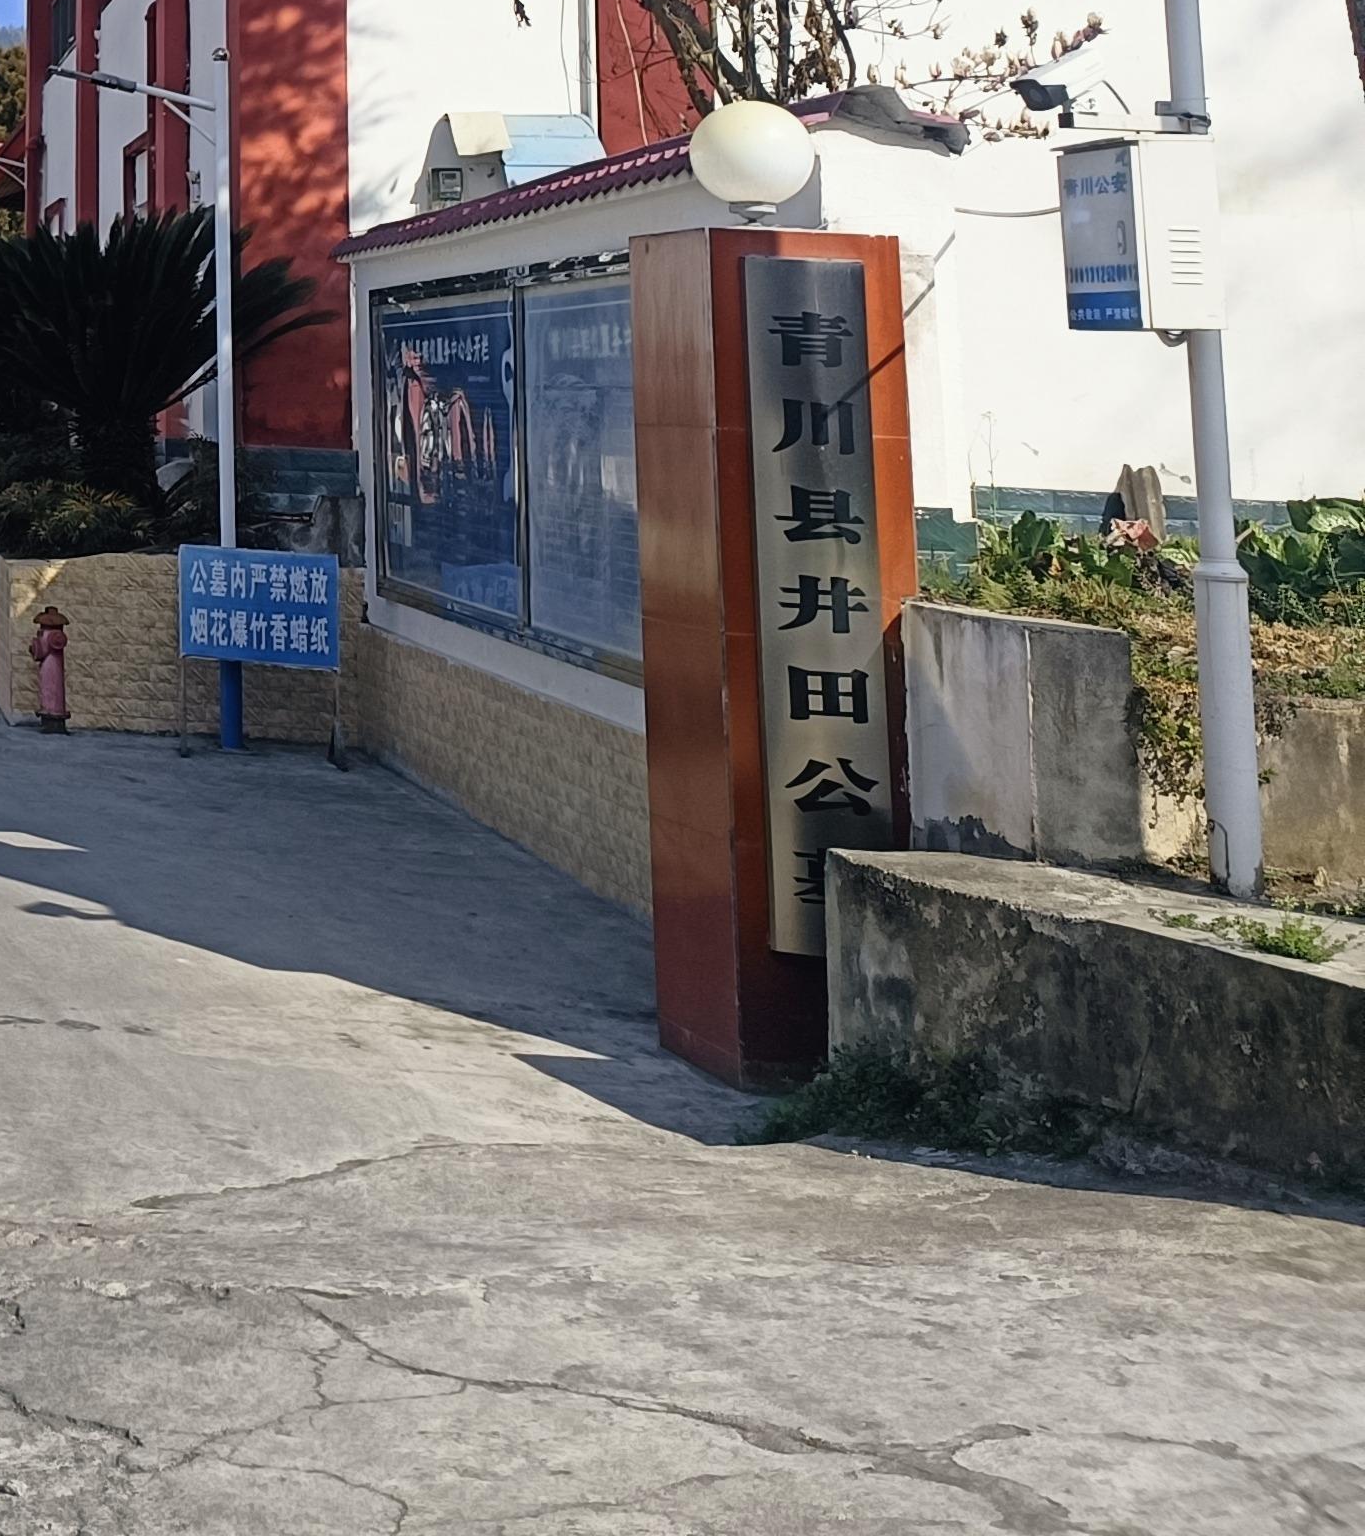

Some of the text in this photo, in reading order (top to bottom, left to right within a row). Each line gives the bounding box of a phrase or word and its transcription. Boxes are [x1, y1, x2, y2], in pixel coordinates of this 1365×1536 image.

[1062, 171, 1128, 199] 青川公安
[189, 559, 329, 605] 公墓内严禁燃放
[189, 607, 331, 655] 烟花爆竹香蜡纸
